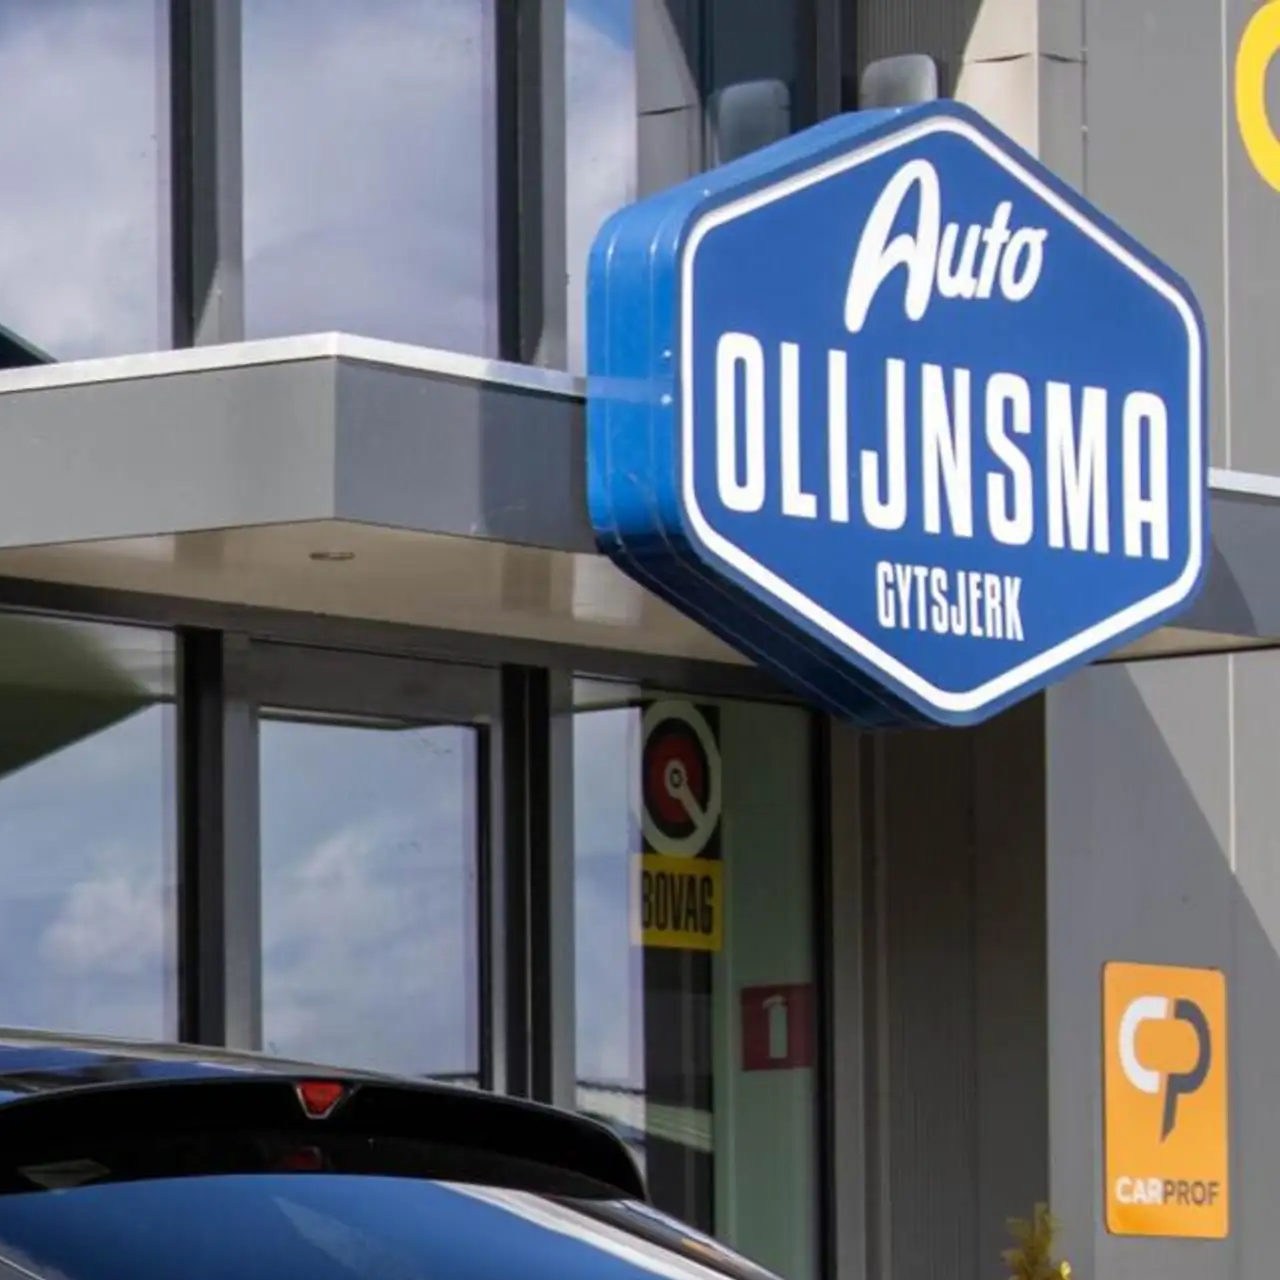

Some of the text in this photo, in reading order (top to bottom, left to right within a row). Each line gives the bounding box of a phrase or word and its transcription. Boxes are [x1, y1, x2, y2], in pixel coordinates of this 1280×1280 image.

[844, 159, 1048, 333] Auto
[716, 331, 1170, 560] OLIJNSMA
[876, 561, 1024, 641] GYTSJERK
[641, 869, 714, 935] BOVAG
[1116, 1176, 1220, 1206] CARPROF
